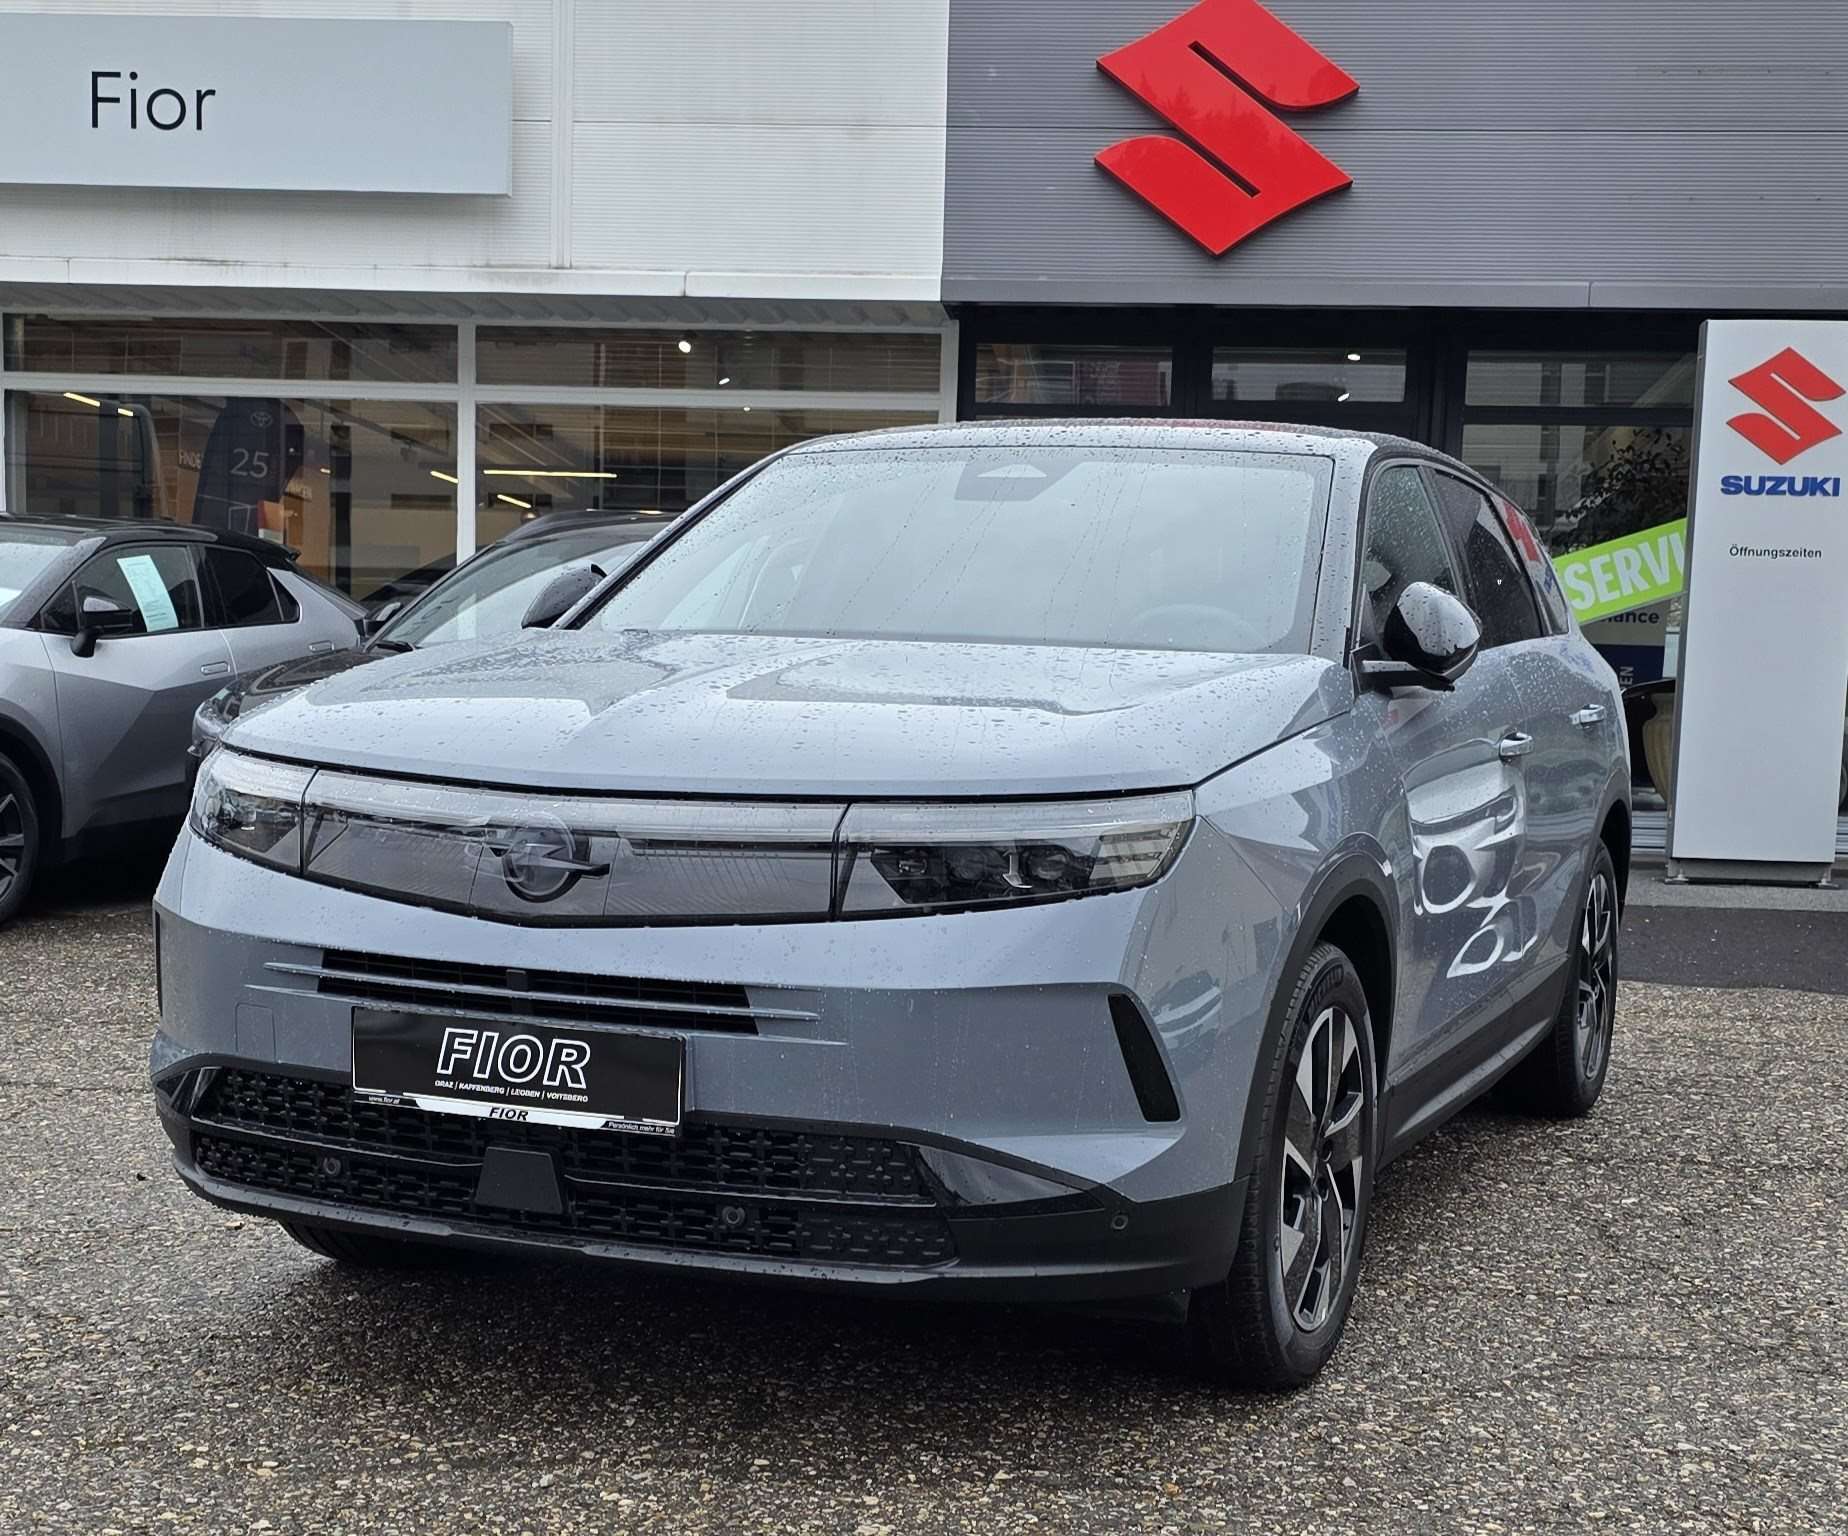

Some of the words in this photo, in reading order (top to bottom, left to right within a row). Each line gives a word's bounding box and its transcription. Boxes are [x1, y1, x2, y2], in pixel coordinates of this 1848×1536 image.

[90, 70, 216, 131] Fior
[229, 447, 270, 479] 25
[1720, 475, 1840, 497] SUZUKI
[1729, 543, 1822, 560] Öffnungszeiten
[436, 1027, 591, 1089] FIOR
[434, 1080, 454, 1089] GRAZ
[488, 1107, 529, 1122] FIOR
[639, 1124, 655, 1132] mehr
